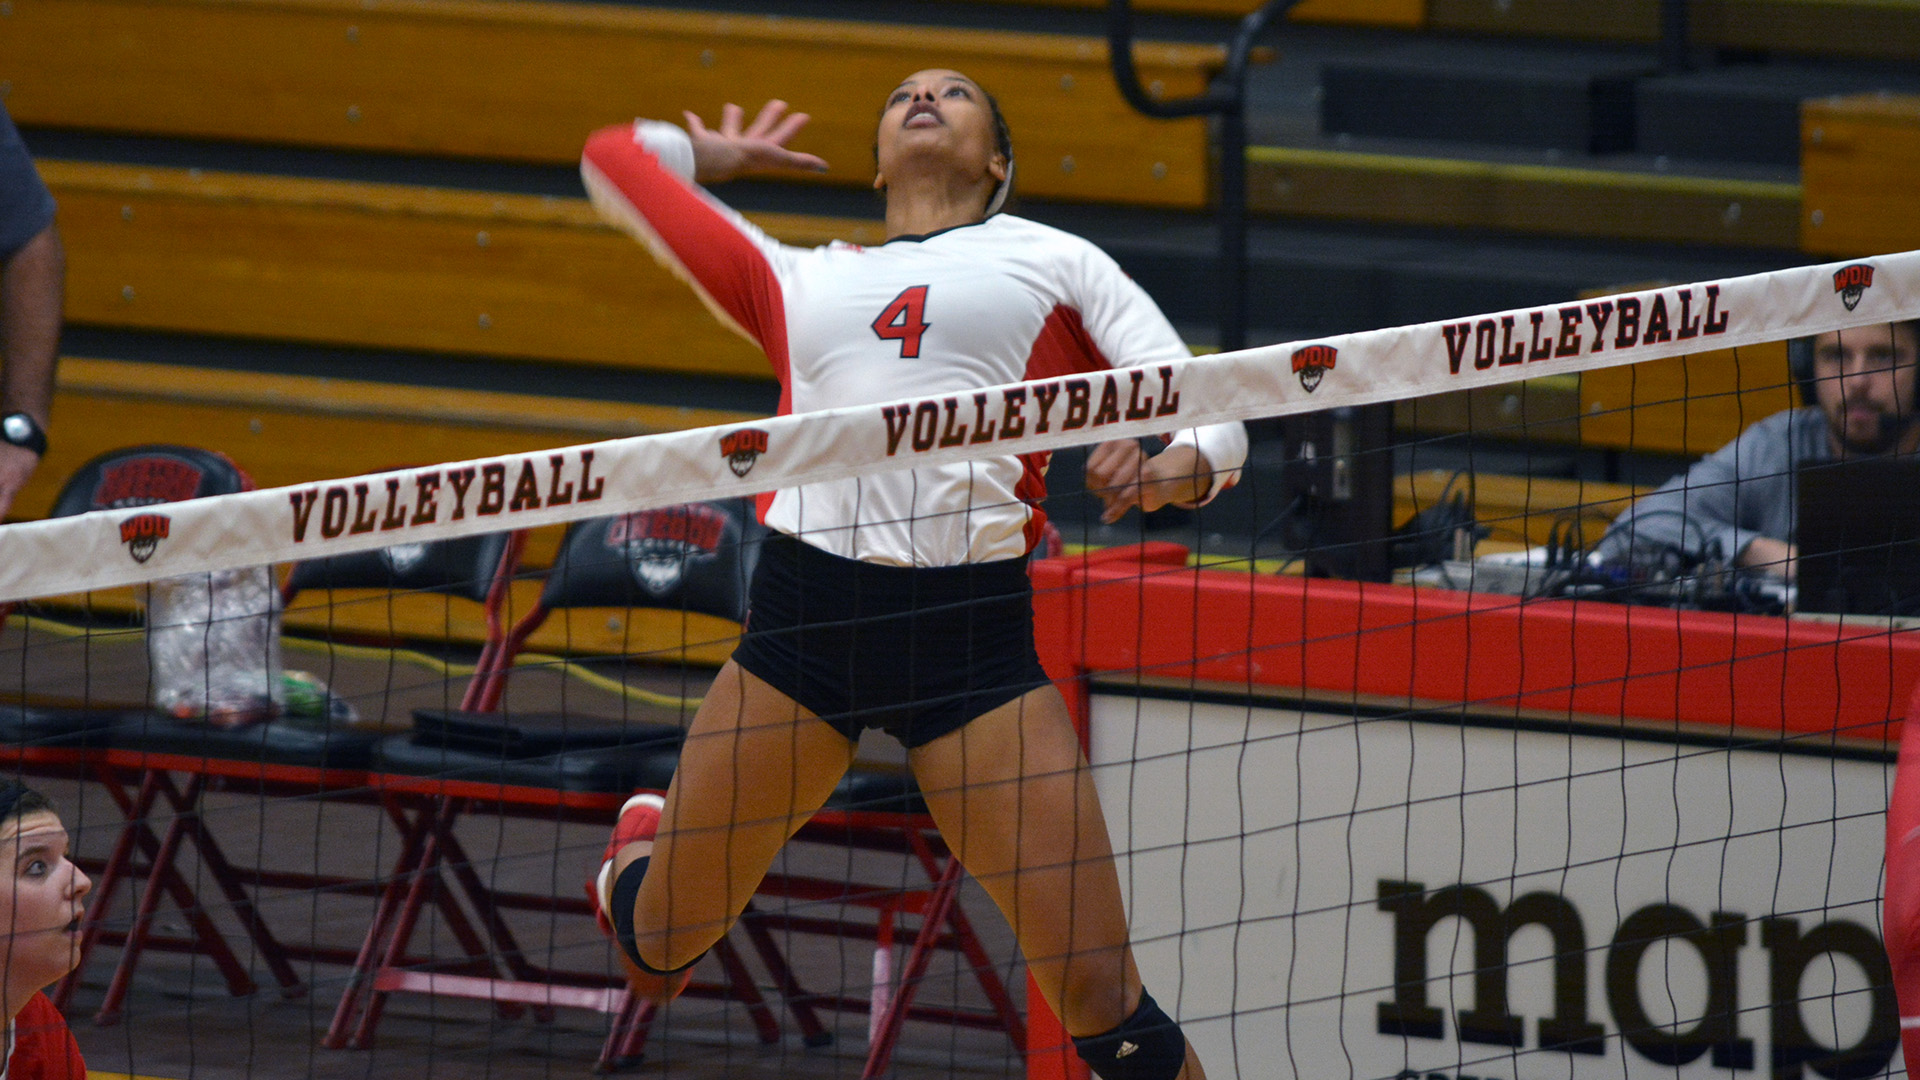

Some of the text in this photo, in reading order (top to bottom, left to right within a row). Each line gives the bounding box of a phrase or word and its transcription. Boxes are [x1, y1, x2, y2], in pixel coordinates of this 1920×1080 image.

[1832, 263, 1875, 294] WOU
[871, 284, 931, 359] 4
[1442, 285, 1729, 375] VOLLEYBALL
[1291, 344, 1338, 375] WOU
[719, 428, 769, 458] WOU
[883, 366, 1180, 456] VOLLEYBALL
[119, 514, 170, 544] WOU
[289, 450, 605, 543] VOLLEYBALL
[1376, 878, 1901, 1080] map
